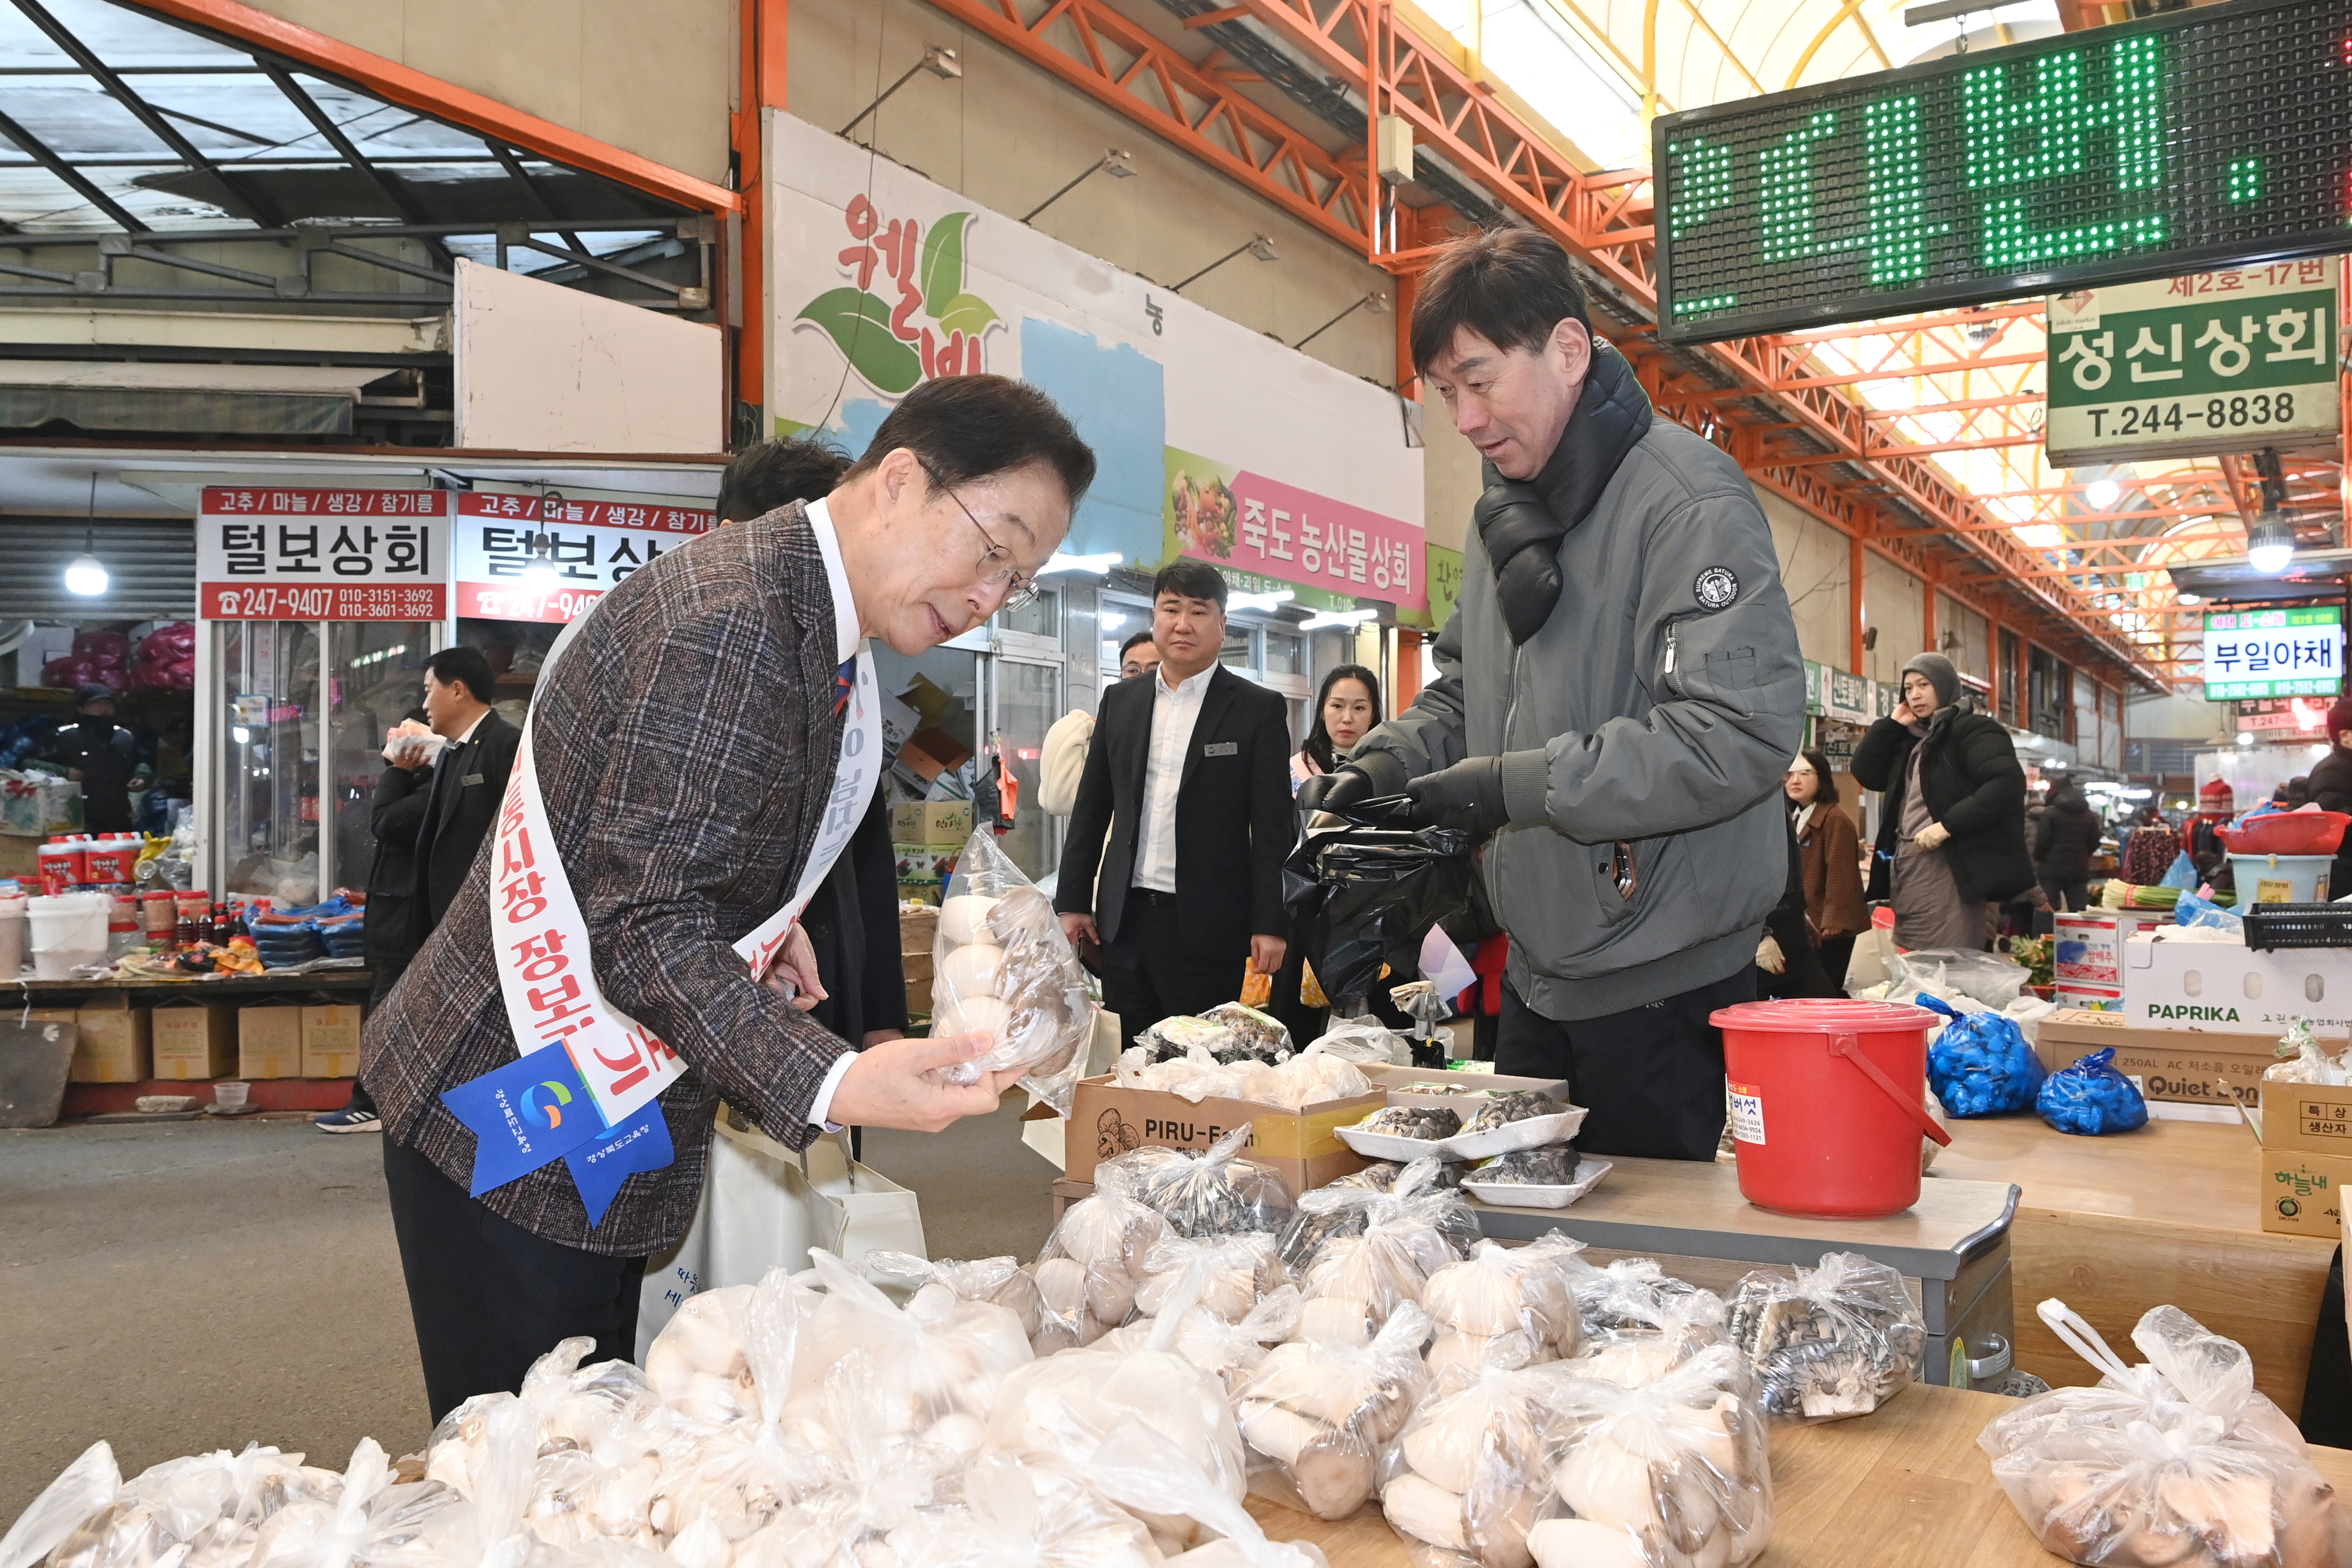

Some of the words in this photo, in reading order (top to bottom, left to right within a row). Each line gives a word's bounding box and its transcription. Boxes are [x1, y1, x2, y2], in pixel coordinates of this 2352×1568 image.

[1145, 294, 1162, 336] 농
[2058, 308, 2326, 391] 성신상회
[2087, 393, 2294, 437] T.244-8838
[220, 493, 253, 511] 고추
[273, 494, 307, 512] 마늘
[327, 494, 362, 513] 생강
[382, 494, 433, 513] 참기름
[480, 495, 521, 516] 고추
[544, 501, 584, 521] 마늘
[607, 505, 645, 526] 생강
[1242, 498, 1293, 560] 죽도
[222, 525, 428, 575] 털보상회
[1696, 569, 1712, 592] SUPREME
[1714, 568, 1734, 581] BATURA
[243, 588, 333, 616] 247-9407
[339, 589, 433, 602] 010-3151-3692
[507, 593, 598, 619] 247-94
[1698, 595, 1720, 608] BATURA
[1721, 583, 1737, 607] OUTDOOR
[339, 604, 433, 617] 010-3601-3692
[2214, 638, 2331, 672] 부일야채
[2149, 1004, 2240, 1022] PAPRIKA
[2123, 1058, 2158, 1068] 250AL
[2168, 1061, 2182, 1069] AC
[2189, 1061, 2224, 1073] 저소음
[2149, 1075, 2210, 1096] Quiet
[495, 1089, 532, 1154] 경상북도교육청
[2335, 1108, 2346, 1118] 상
[2309, 1122, 2346, 1134] 생산자
[586, 1124, 650, 1164] 경상북도교육청
